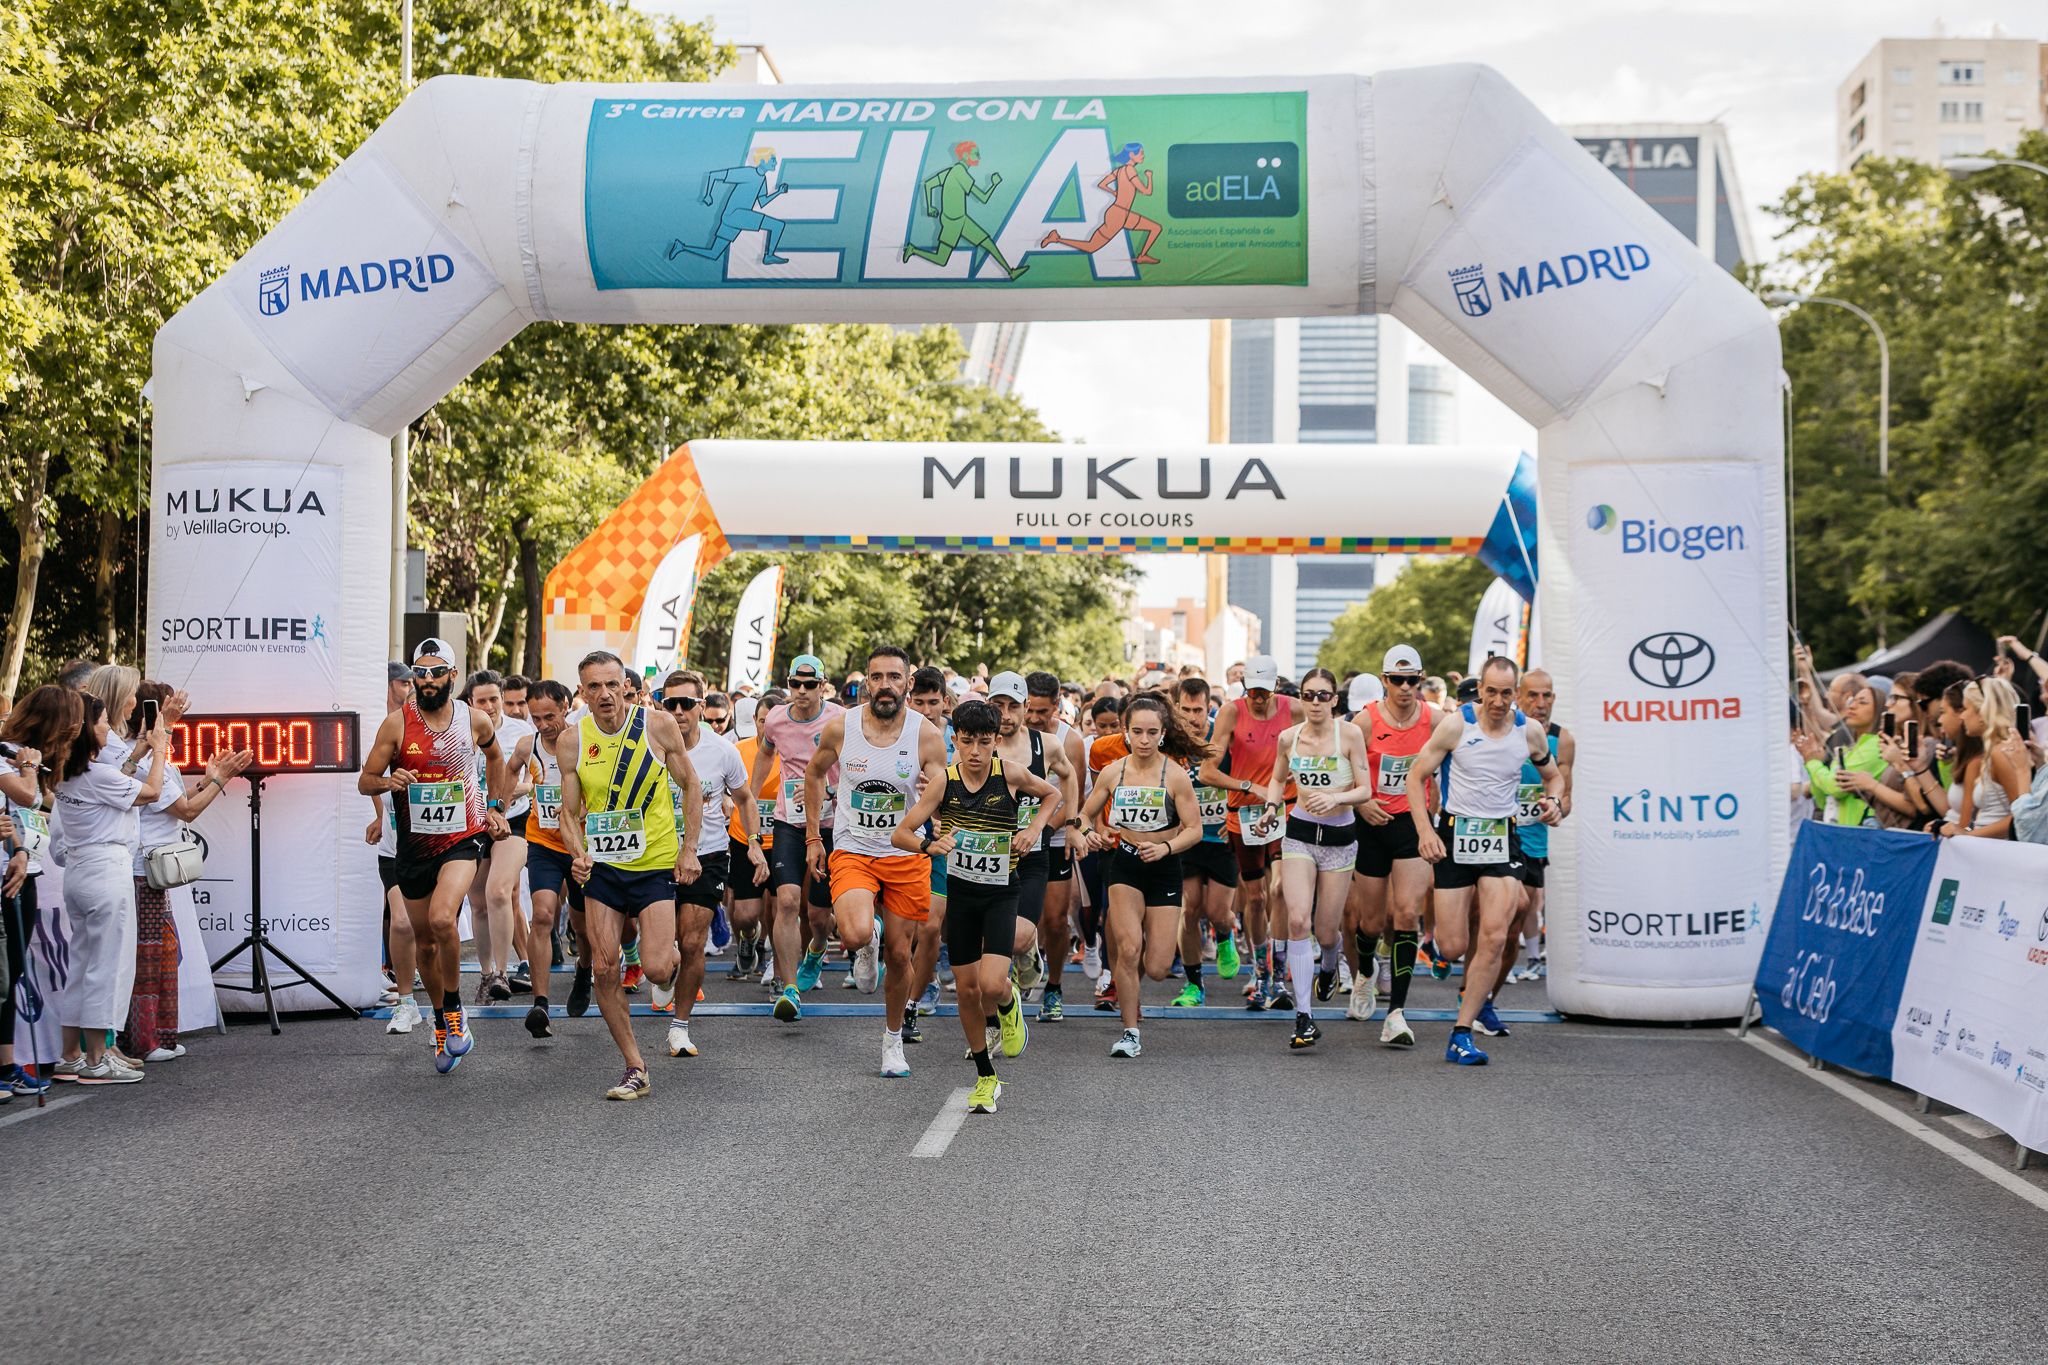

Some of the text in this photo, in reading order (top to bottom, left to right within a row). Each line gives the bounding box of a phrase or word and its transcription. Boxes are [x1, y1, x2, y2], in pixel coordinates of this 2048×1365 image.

[605, 99, 1108, 123] 3ª Carrera MADRID CON LA
[722, 126, 1141, 283] ELA
[300, 254, 455, 302] MADRID
[1498, 244, 1650, 302] MADRID
[922, 456, 1287, 500] MUKUA
[167, 488, 326, 516] MUKUA
[1016, 512, 1194, 528] FULL OF COLOURS
[166, 518, 291, 541] by VelillaGroup.
[1622, 519, 1745, 560] Biogen
[162, 642, 306, 654] MOVILIDAD, COMUNICACIÓN Y EVENTOS
[1300, 757, 1328, 769] ELA
[1300, 773, 1331, 786] 828
[421, 786, 453, 802] ELA
[861, 796, 893, 811] ELA
[420, 805, 456, 823] 447
[597, 814, 630, 832] ELA
[858, 812, 897, 828] 1161
[1121, 808, 1160, 823] 1767
[1466, 821, 1497, 835] ELA
[1613, 829, 1740, 841] Flexible Mobility Solutions
[593, 833, 640, 853] 1224
[961, 836, 997, 853] ELA
[1458, 838, 1504, 853] 1094
[955, 851, 1001, 873] 1143
[1588, 909, 1745, 936] SPORTLIFE
